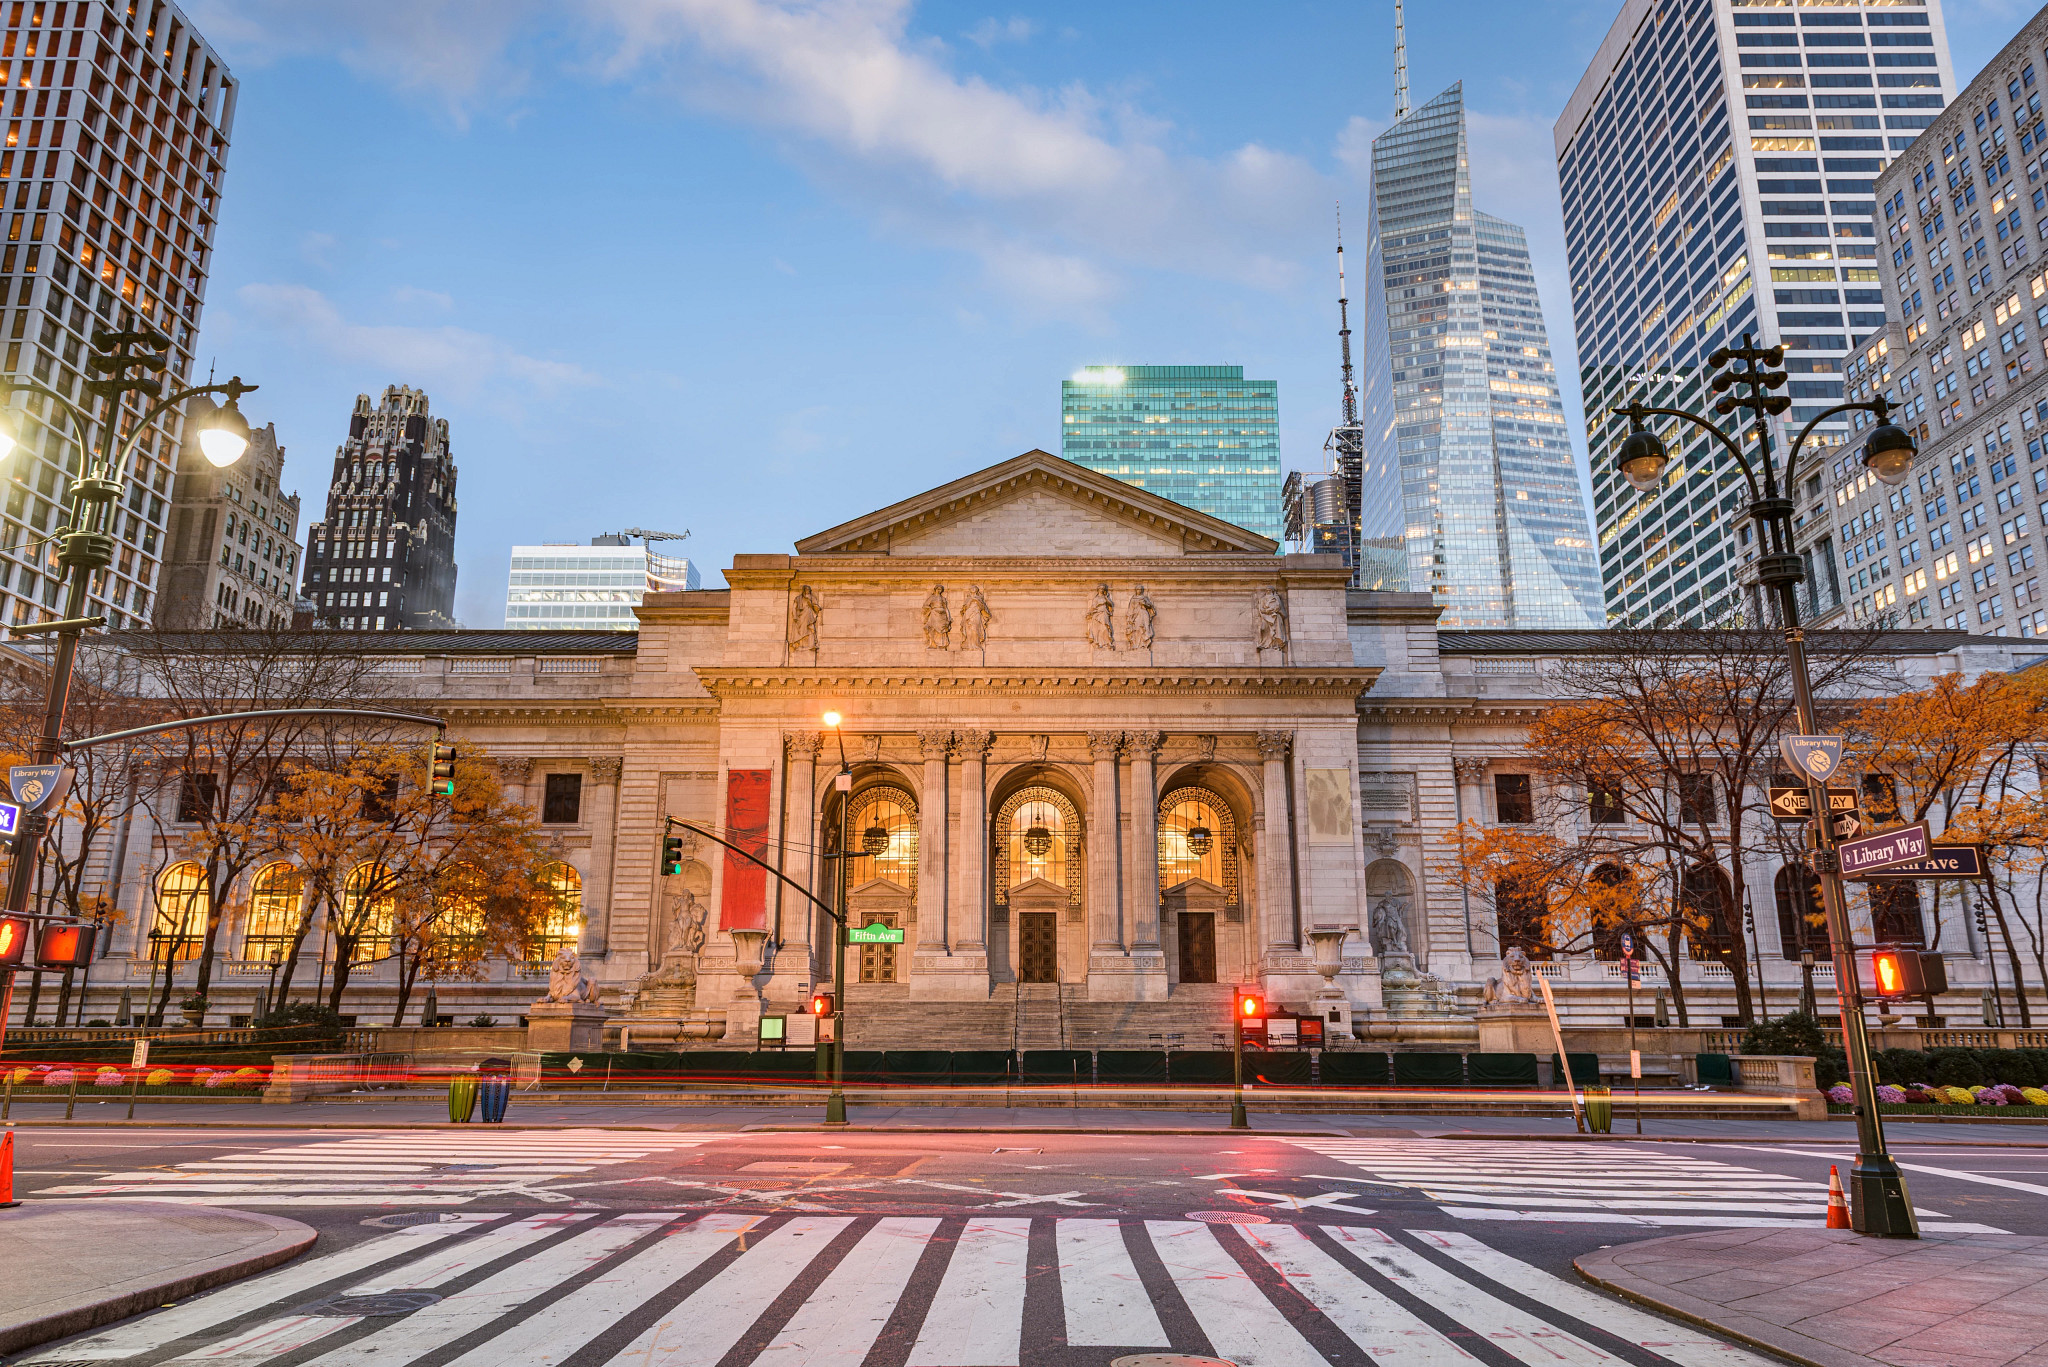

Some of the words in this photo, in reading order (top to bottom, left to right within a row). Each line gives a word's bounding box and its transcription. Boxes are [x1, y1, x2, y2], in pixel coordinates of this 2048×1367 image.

[1795, 739, 1820, 748] Library
[1822, 740, 1838, 748] Way
[1783, 797, 1806, 808] ONE
[1832, 797, 1846, 807] AY
[1840, 820, 1854, 833] WAY
[1852, 845, 1894, 865] Library
[1895, 837, 1923, 855] Way
[1925, 859, 1959, 870] Ave
[855, 931, 876, 940] Fifth
[878, 931, 896, 940] Ave
